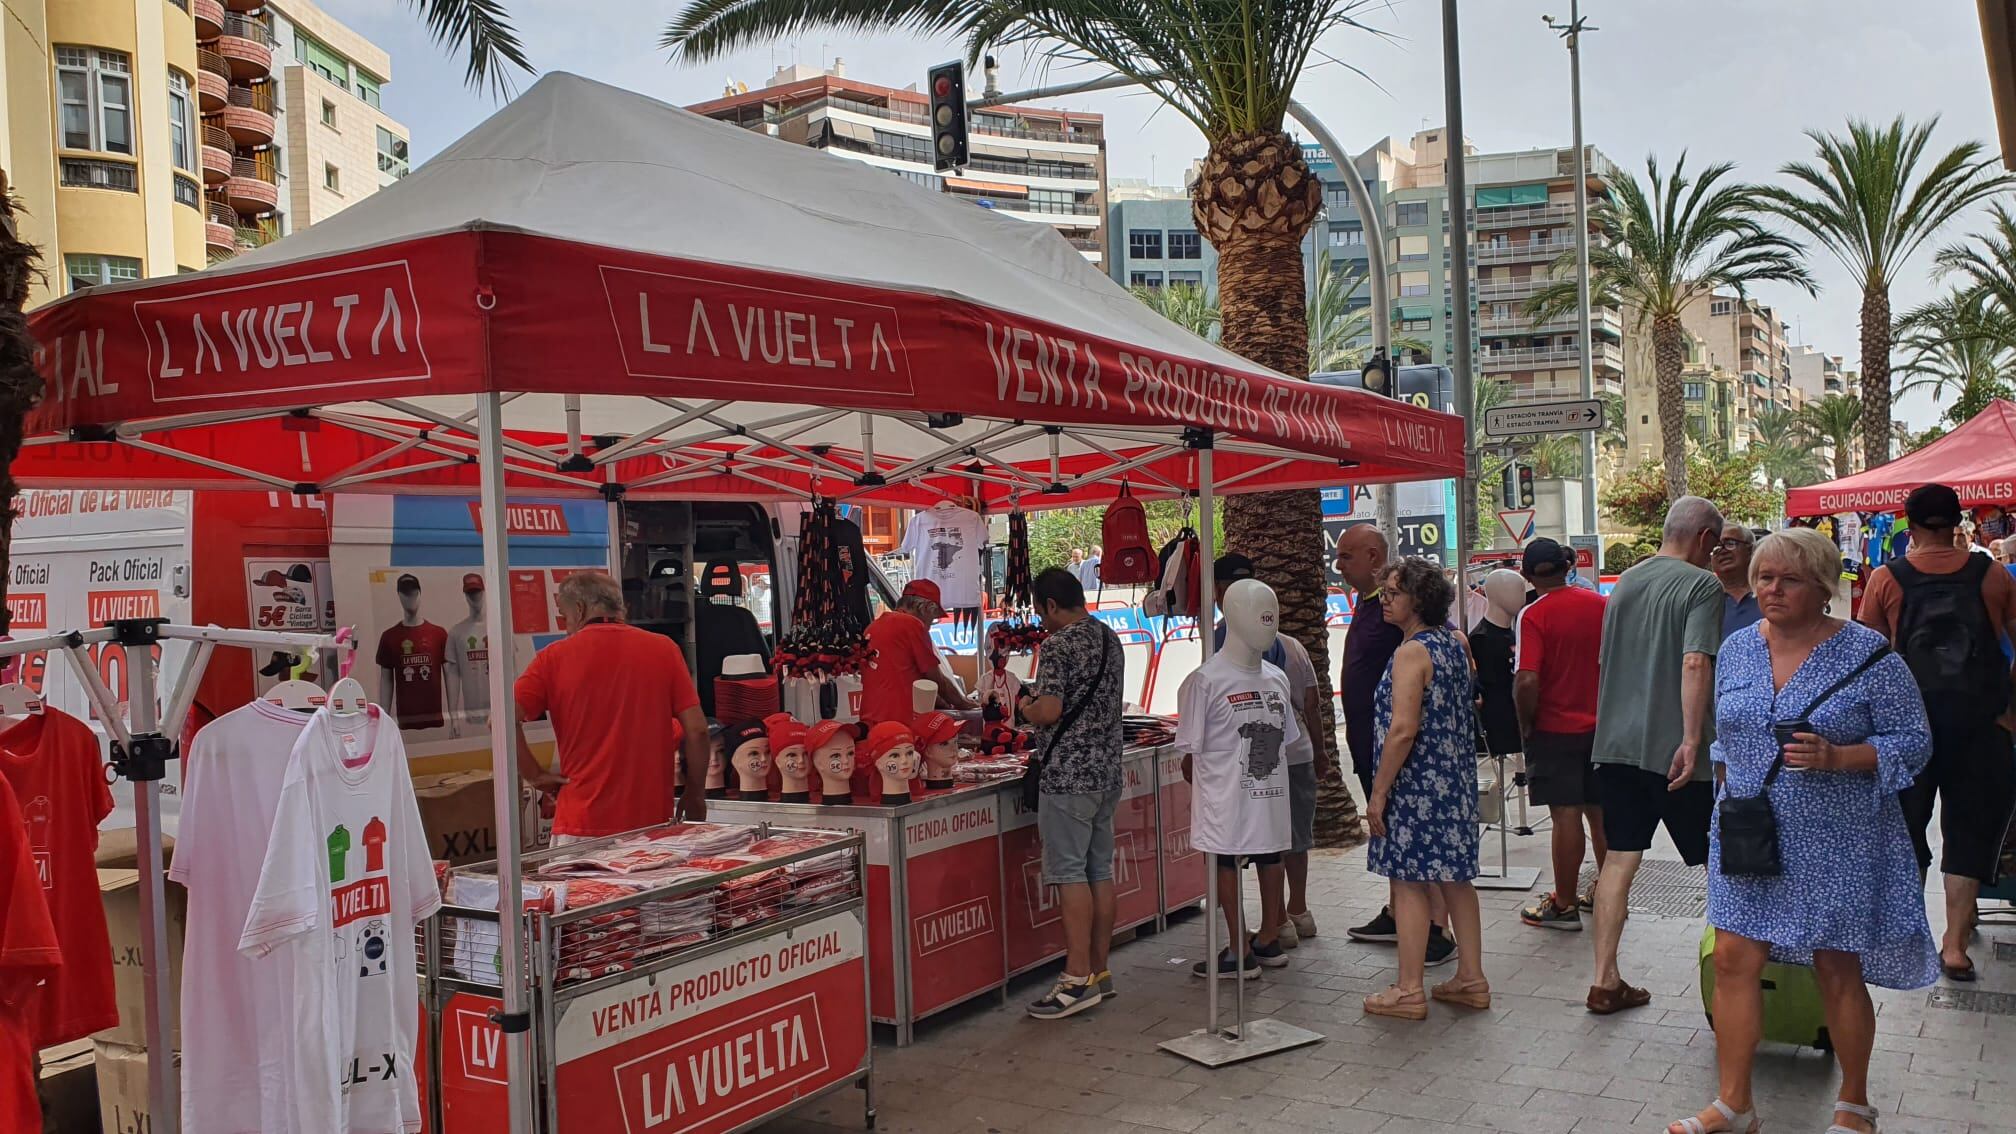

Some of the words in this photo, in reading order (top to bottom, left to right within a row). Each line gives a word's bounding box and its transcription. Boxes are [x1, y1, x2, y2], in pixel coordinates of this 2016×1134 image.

[221, 287, 407, 372] VUELTA
[640, 292, 719, 357] LA
[727, 303, 896, 373] VUELTA
[985, 321, 1108, 411] VENTA
[1118, 351, 1259, 433] PRODUCTO
[1261, 383, 1352, 449] OFICIAL
[1506, 411, 1537, 420] ESTACIÓN
[1538, 409, 1563, 417] TRANVÍA
[1506, 420, 1532, 428] ESTACIÓ
[1534, 419, 1560, 427] TRAMVIA
[1405, 420, 1446, 456] VUELTA
[29, 490, 73, 518] Oficial
[80, 490, 98, 514] de
[1819, 488, 1910, 511] EQUIPACIONES
[15, 563, 50, 586] Oficial
[89, 560, 120, 583] Pack
[123, 557, 163, 581] Oficial
[109, 595, 154, 622] VUELTA
[257, 605, 287, 628] 5€
[441, 826, 498, 859] XXL
[905, 816, 949, 847] TIENDA
[952, 806, 995, 834] OFICIAL
[922, 918, 940, 947] LA
[938, 903, 987, 942] VUELTA
[592, 994, 662, 1037] VENTA
[670, 954, 772, 1012] PRODUCTO
[778, 930, 842, 978] OFICIAL
[641, 1064, 687, 1129] LA
[687, 1014, 809, 1107] VUELTA
